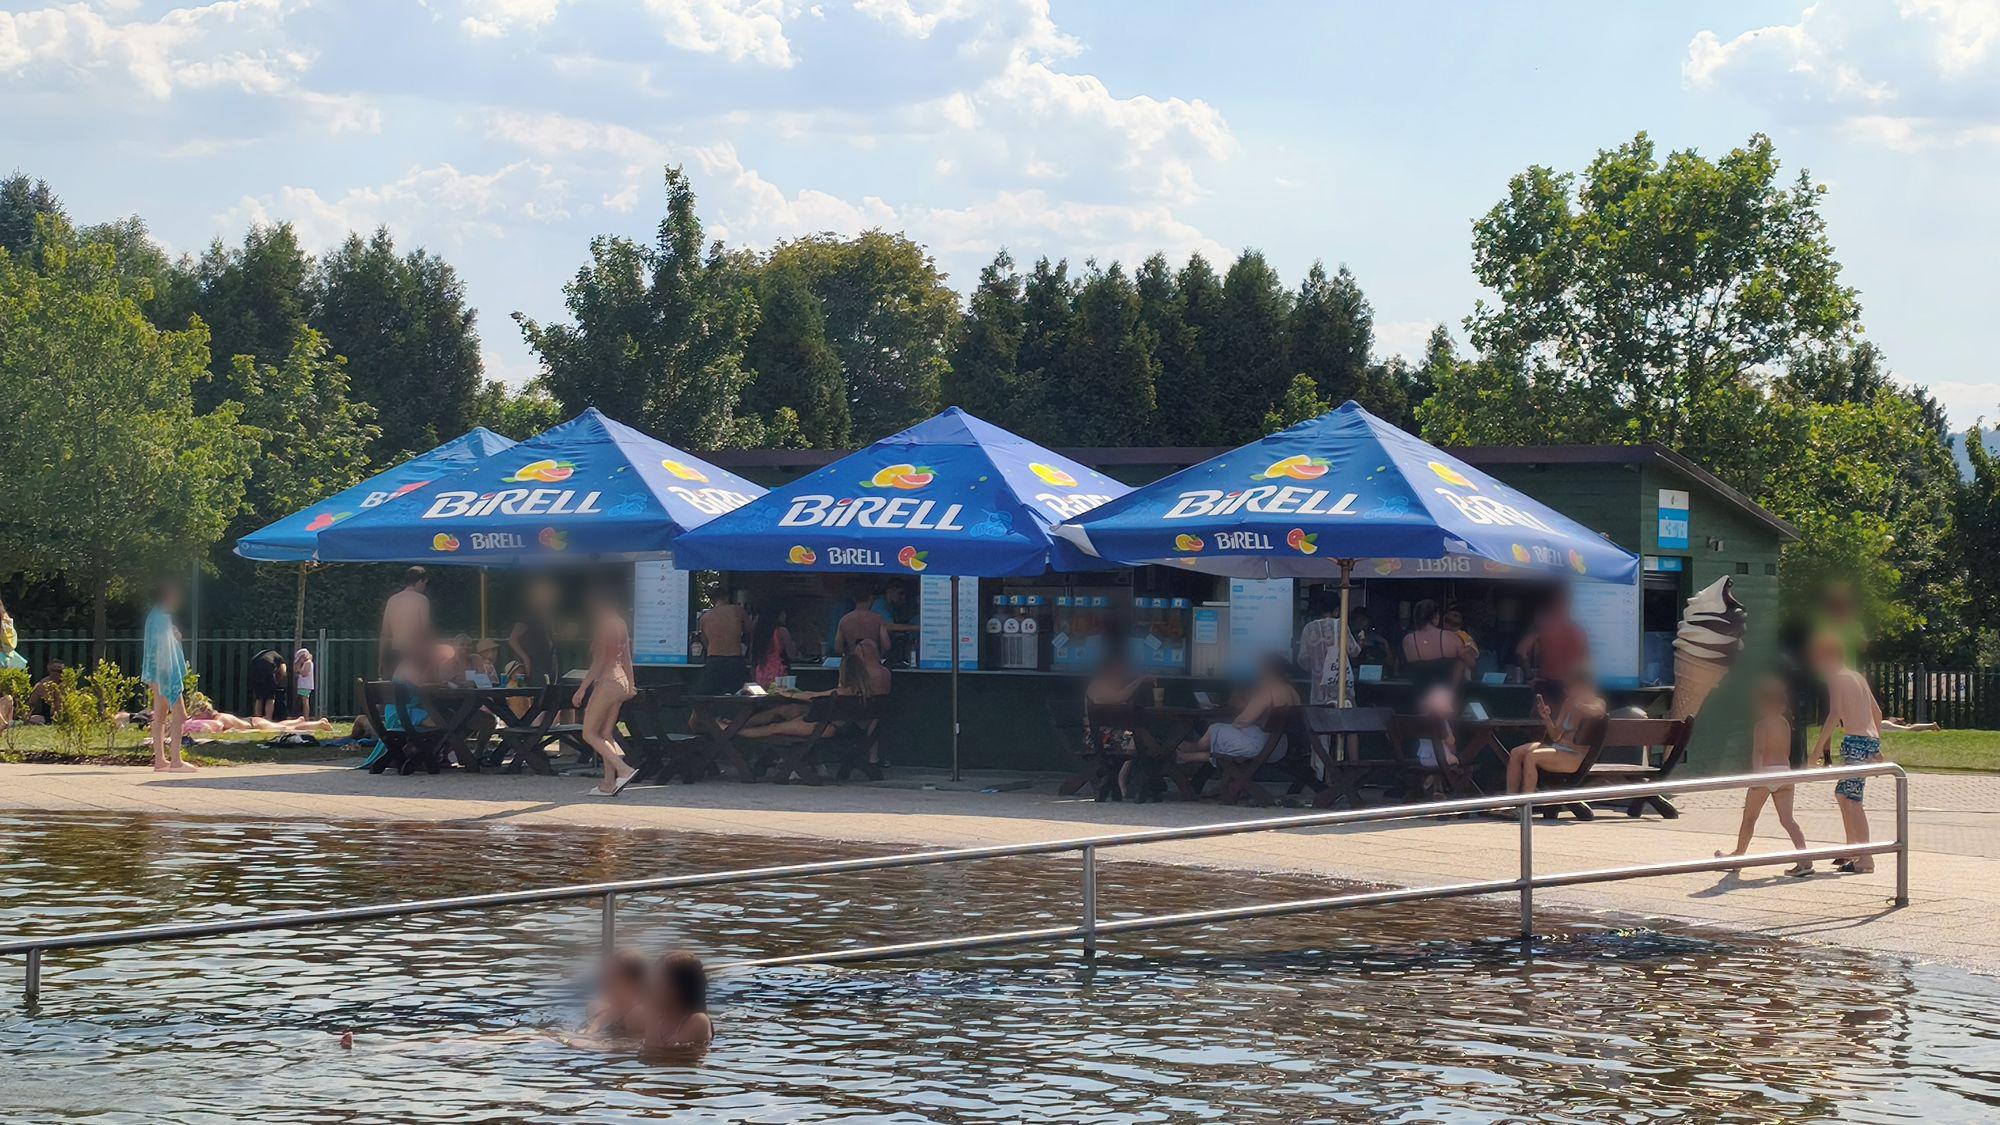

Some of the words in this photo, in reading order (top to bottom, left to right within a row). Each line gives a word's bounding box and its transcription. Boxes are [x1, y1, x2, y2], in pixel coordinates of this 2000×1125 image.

[422, 488, 602, 518] BiRELL
[778, 494, 965, 531] BiRELL
[1162, 485, 1359, 519] BiRELL
[1214, 531, 1274, 550] BiRELL
[827, 546, 885, 566] BiRELL
